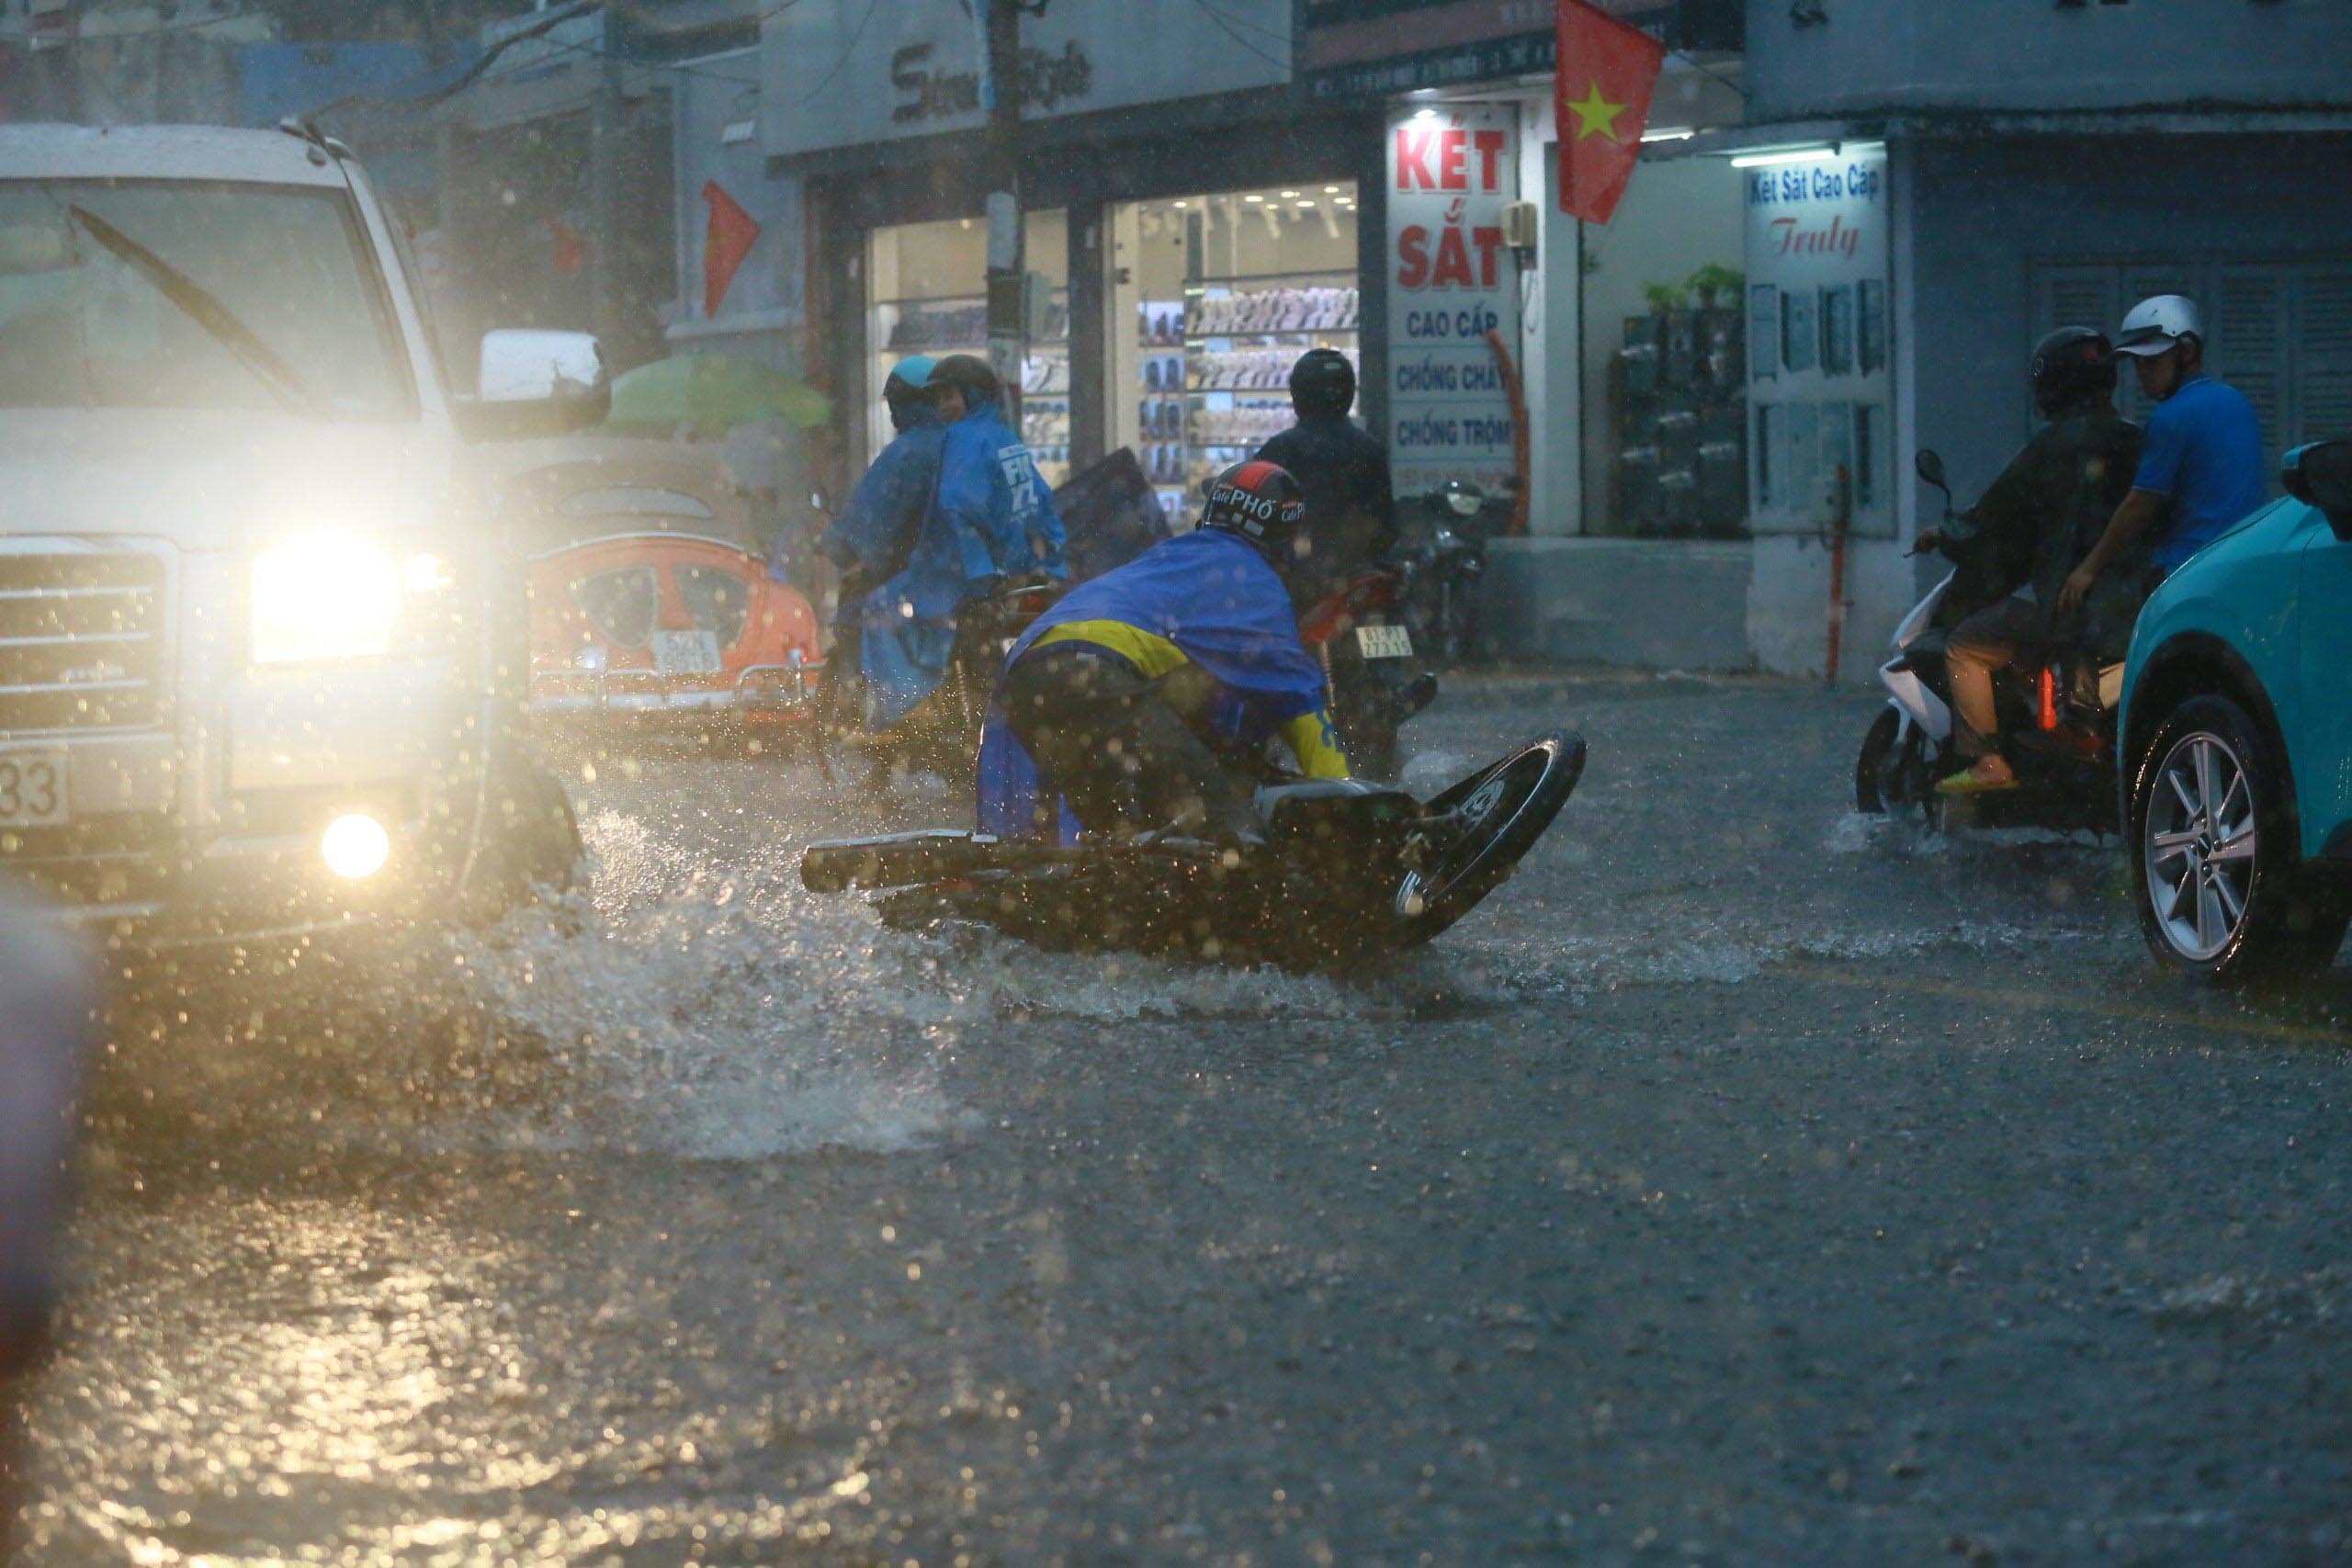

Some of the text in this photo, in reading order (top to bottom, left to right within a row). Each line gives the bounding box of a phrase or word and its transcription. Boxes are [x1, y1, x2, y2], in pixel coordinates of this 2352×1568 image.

[1396, 112, 1507, 193] KÉT
[1813, 167, 1842, 198] Cao
[1398, 197, 1504, 289] SẮT
[1770, 215, 1859, 260] Truly
[1407, 310, 1449, 337] CAO
